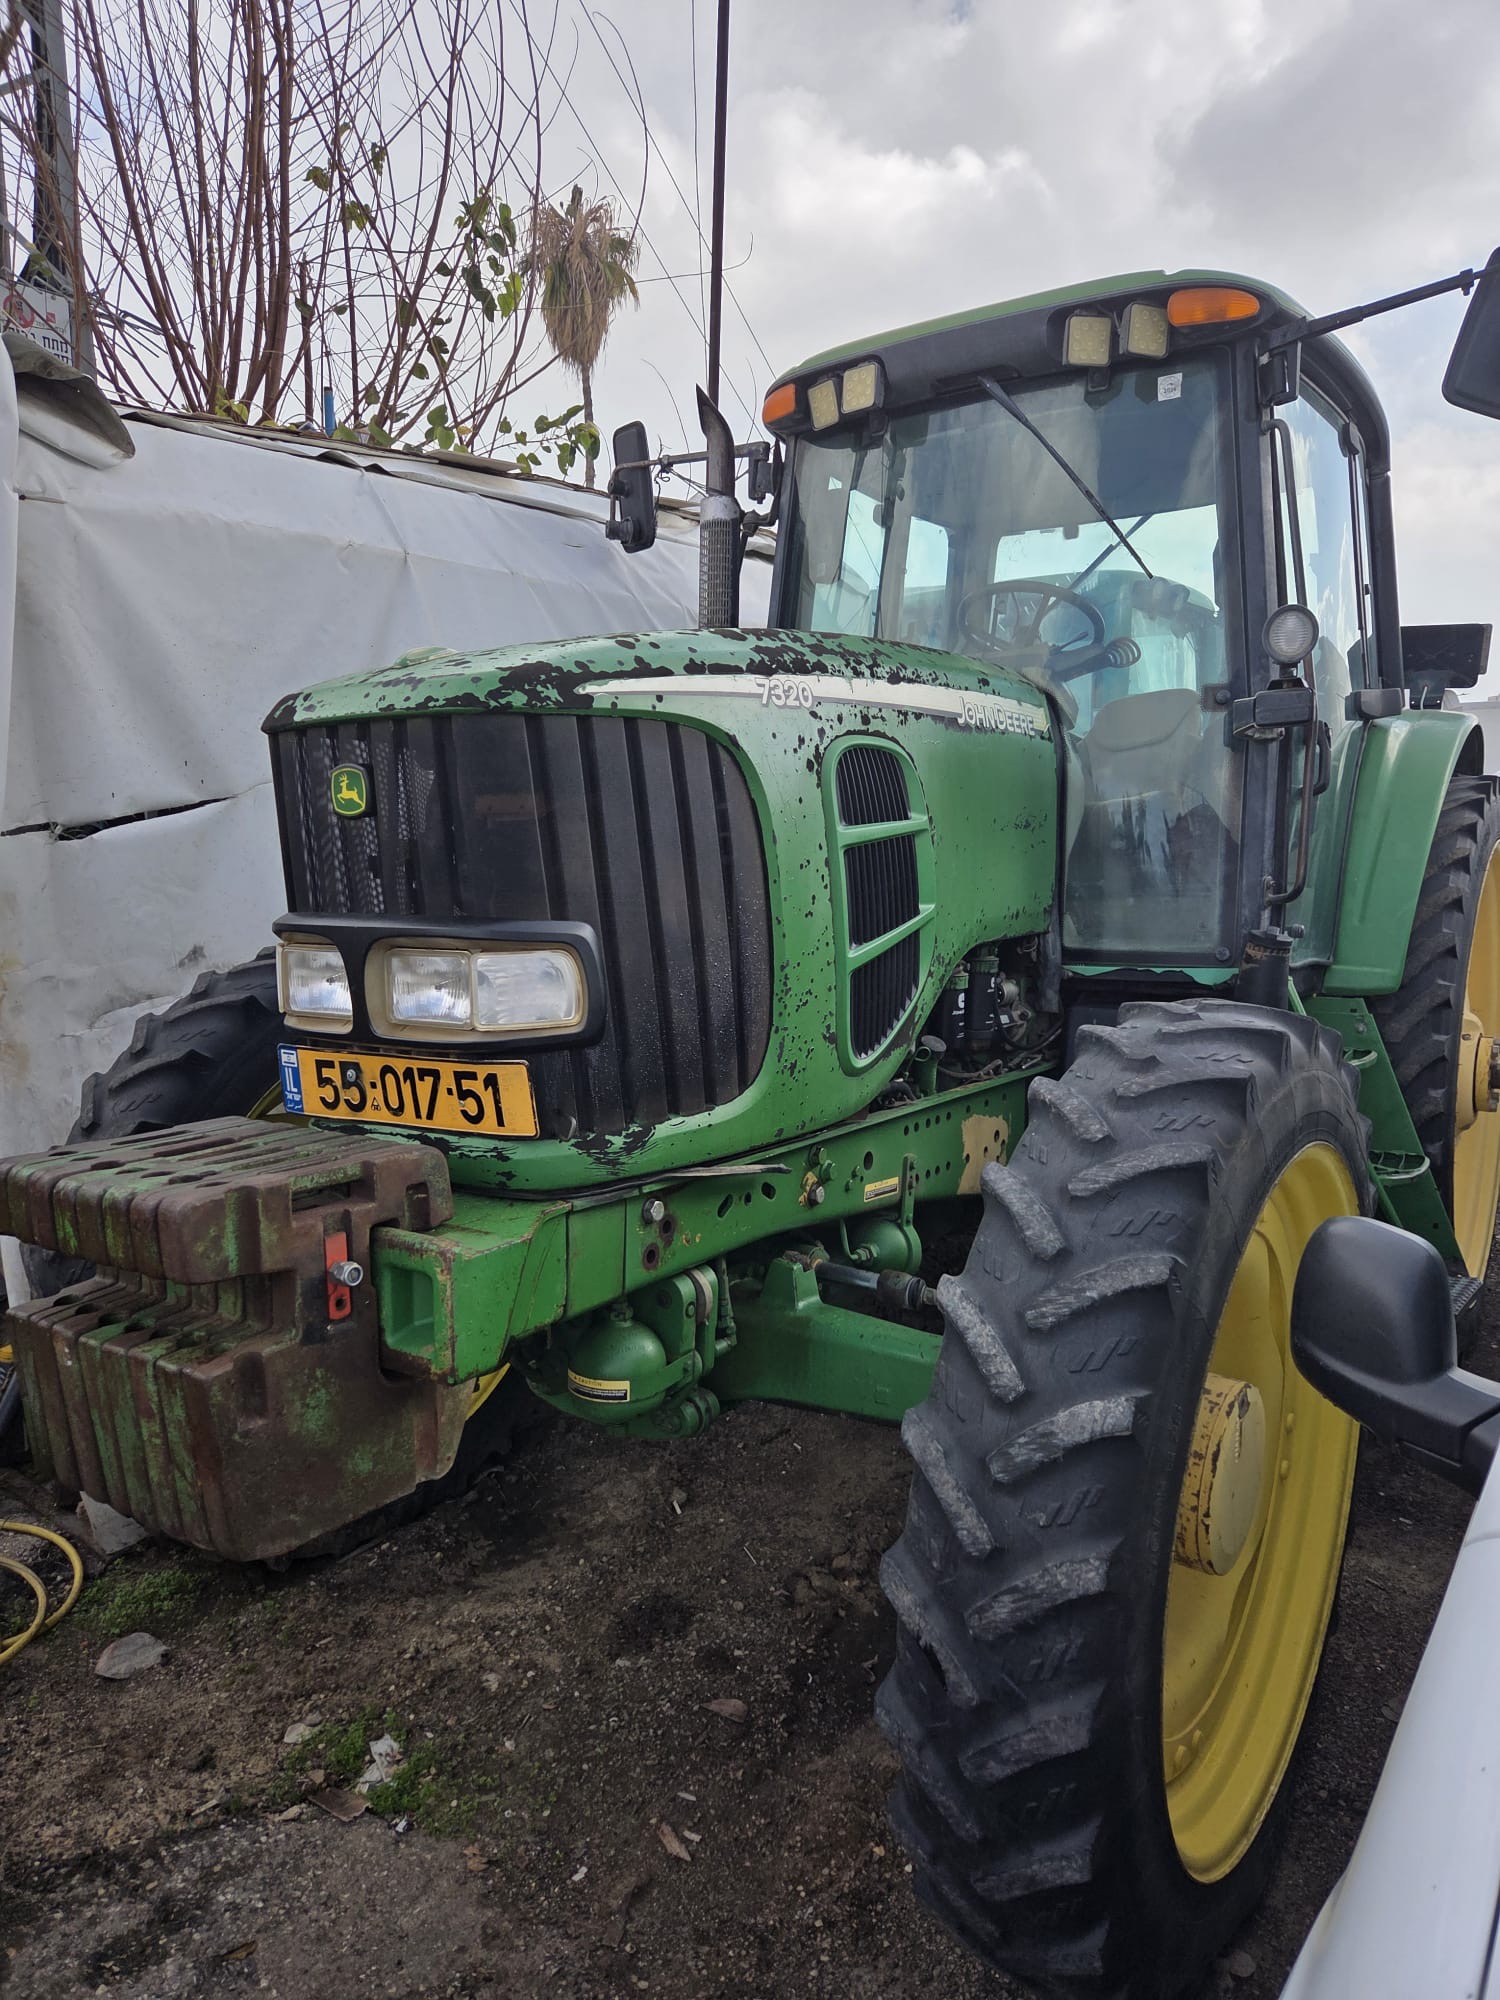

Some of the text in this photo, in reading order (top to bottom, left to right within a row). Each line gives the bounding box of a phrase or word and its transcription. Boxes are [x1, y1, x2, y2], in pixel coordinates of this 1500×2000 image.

[754, 677, 813, 709] 7320
[957, 696, 1036, 736] JOHN DEERE
[285, 1067, 298, 1093] IL
